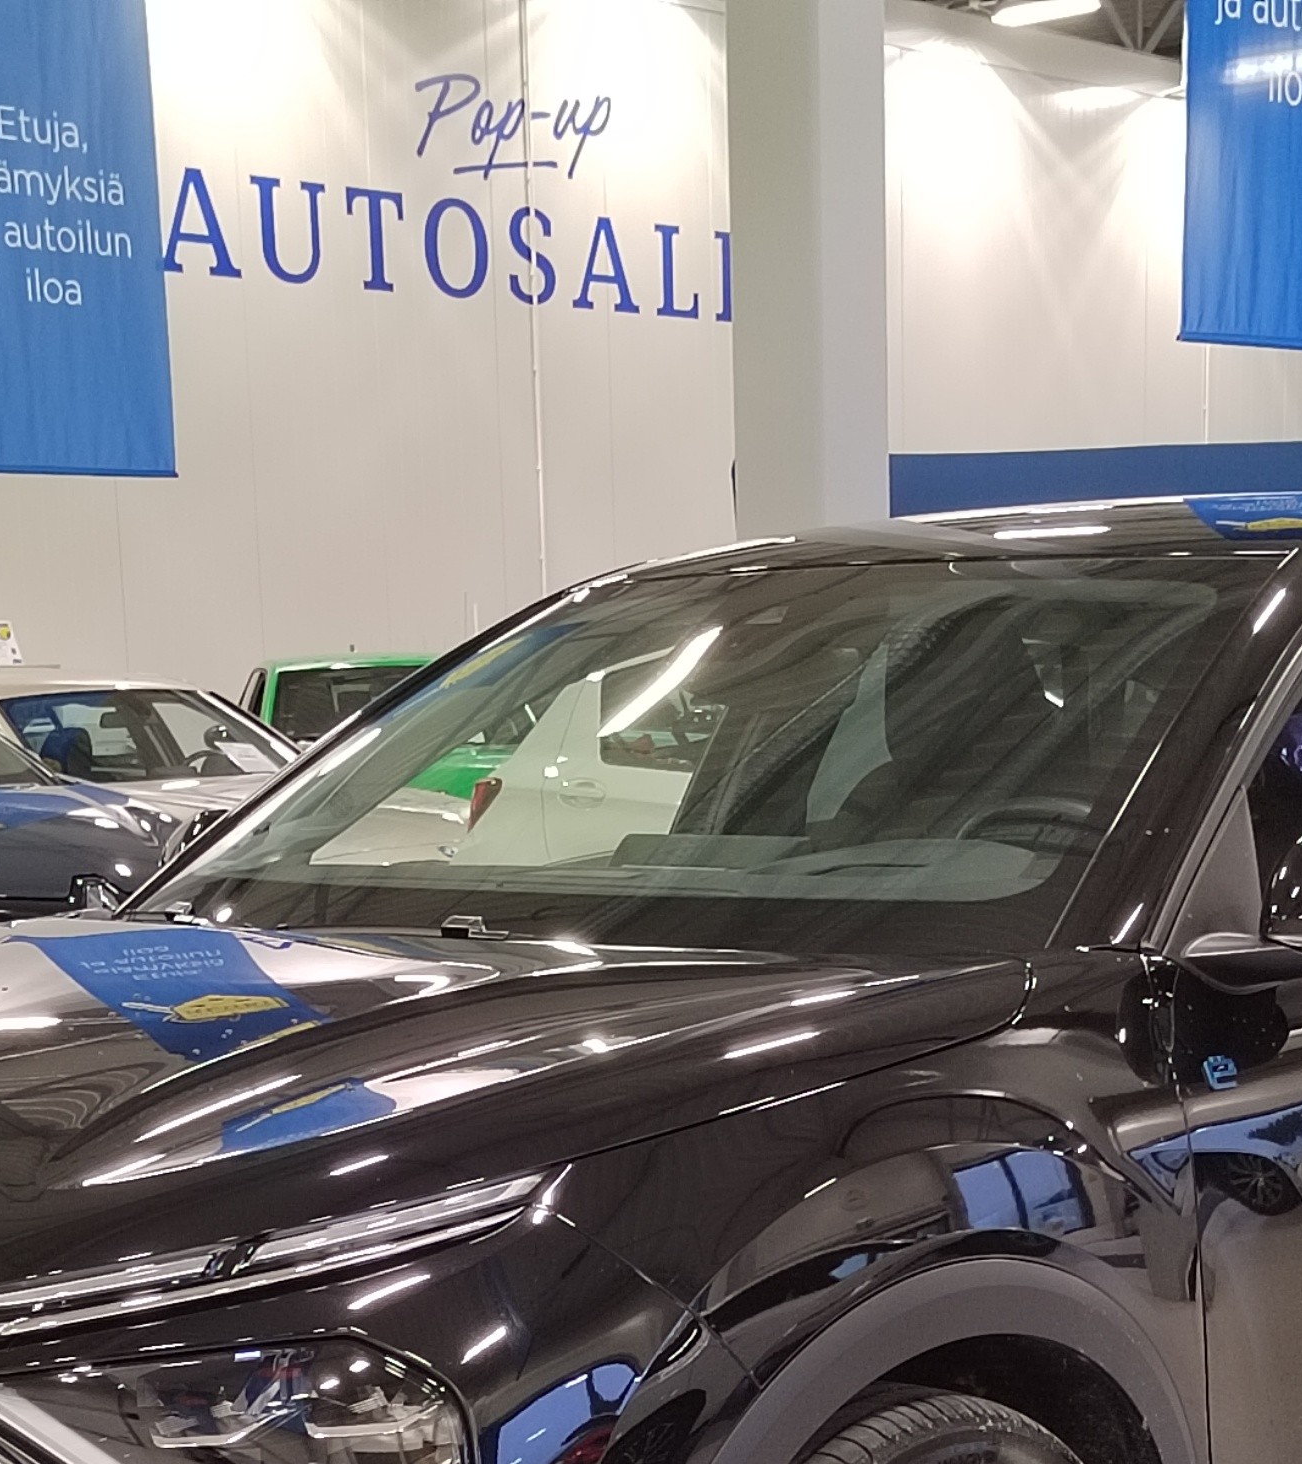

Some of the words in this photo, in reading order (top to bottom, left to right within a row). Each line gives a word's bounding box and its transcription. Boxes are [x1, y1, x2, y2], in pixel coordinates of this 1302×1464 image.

[1214, 0, 1242, 26] ja
[414, 73, 613, 180] Pop-up
[3, 219, 133, 261] autoilun
[25, 266, 84, 307] iloa
